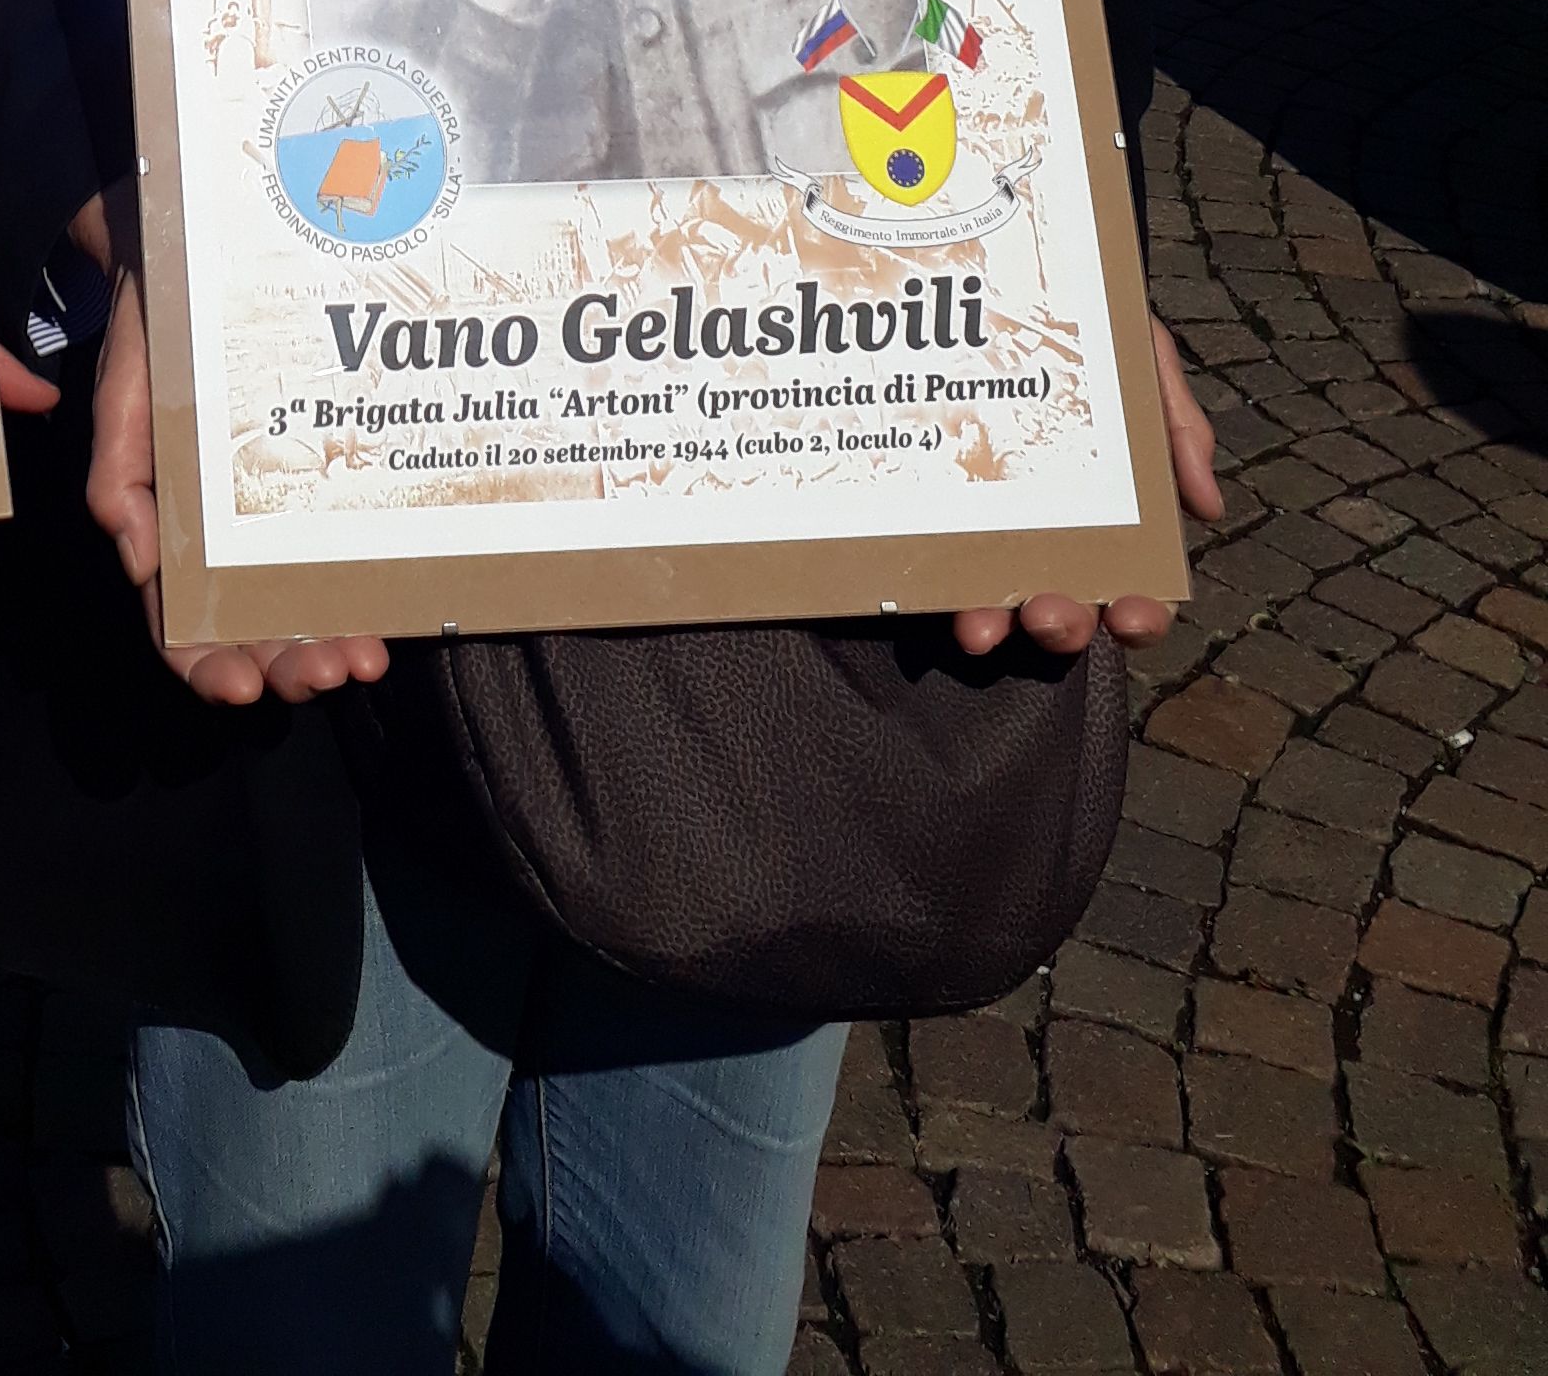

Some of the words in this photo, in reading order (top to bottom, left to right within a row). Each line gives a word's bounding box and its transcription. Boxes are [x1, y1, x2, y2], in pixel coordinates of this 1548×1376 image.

[303, 47, 381, 75] DENTRO
[386, 53, 407, 75] LA
[410, 69, 462, 145] GUERRA
[262, 173, 348, 260] FERDINANDO
[352, 227, 429, 262] PASCOLO
[820, 210, 893, 242] Reggimento
[896, 227, 958, 242] Immortale
[960, 220, 973, 234] in
[973, 206, 1003, 230] Italia
[324, 301, 538, 372] Vano
[562, 275, 988, 364] Gelashvili
[313, 396, 445, 434] Brigata
[452, 389, 540, 423] Julia
[697, 375, 876, 418] (provincia
[883, 373, 916, 404] di
[924, 366, 1051, 403] Parma)
[388, 446, 479, 471] Caduto
[485, 444, 502, 466] il
[508, 447, 538, 466] 20
[543, 438, 666, 464] settembre
[672, 438, 729, 462] 1944
[736, 432, 805, 460] (cubo
[809, 435, 830, 456] 2,
[836, 427, 913, 452] loculo
[919, 424, 942, 452] 4)
